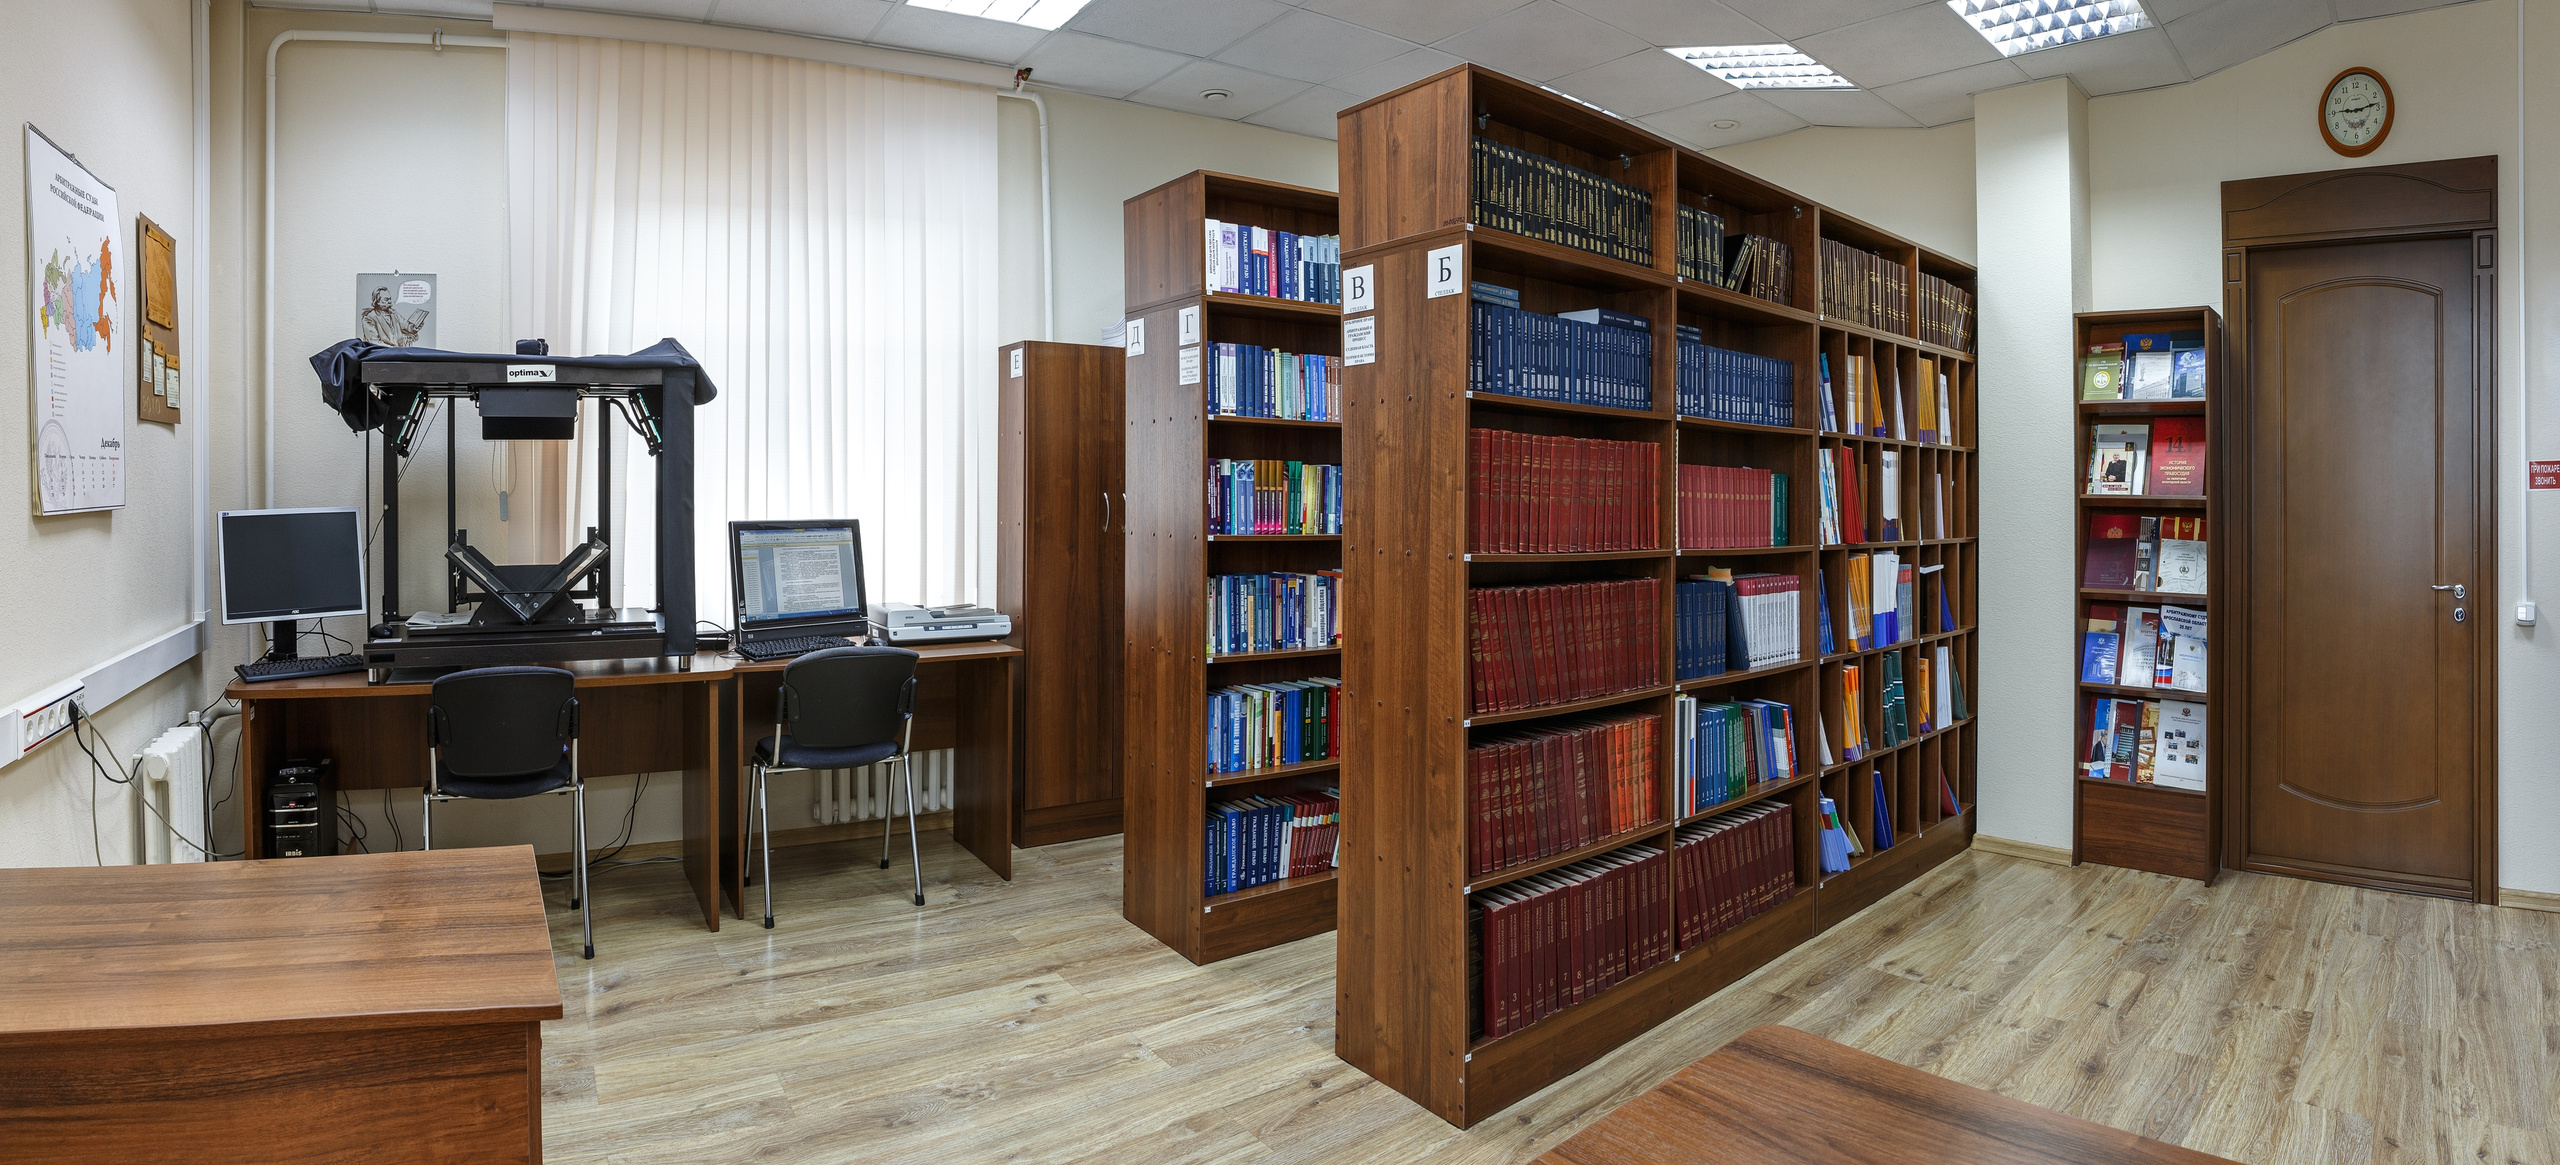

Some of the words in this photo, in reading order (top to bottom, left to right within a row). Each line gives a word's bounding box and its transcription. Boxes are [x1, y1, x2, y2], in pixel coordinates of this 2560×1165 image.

[2376, 102, 2380, 111] 3
[1438, 256, 1451, 283] Б
[1351, 276, 1365, 300] В
[1186, 314, 1193, 333] Г
[1131, 326, 1140, 349] Д
[1015, 355, 1019, 369] Е
[509, 369, 538, 377] optima
[101, 438, 120, 450] Декабрь
[2531, 465, 2540, 473] ПРИ
[2541, 464, 2560, 473] ПОЖАРЕ
[2535, 476, 2556, 485] ЗВОНИТЬ
[1744, 891, 1749, 899] 24
[1599, 958, 1604, 966] 10
[1577, 971, 1581, 979] 8
[1550, 978, 1553, 986] 6
[1527, 988, 1530, 996] 4
[1538, 984, 1542, 992] 5
[1512, 993, 1517, 1002] 3
[1501, 1000, 1504, 1010] 2
